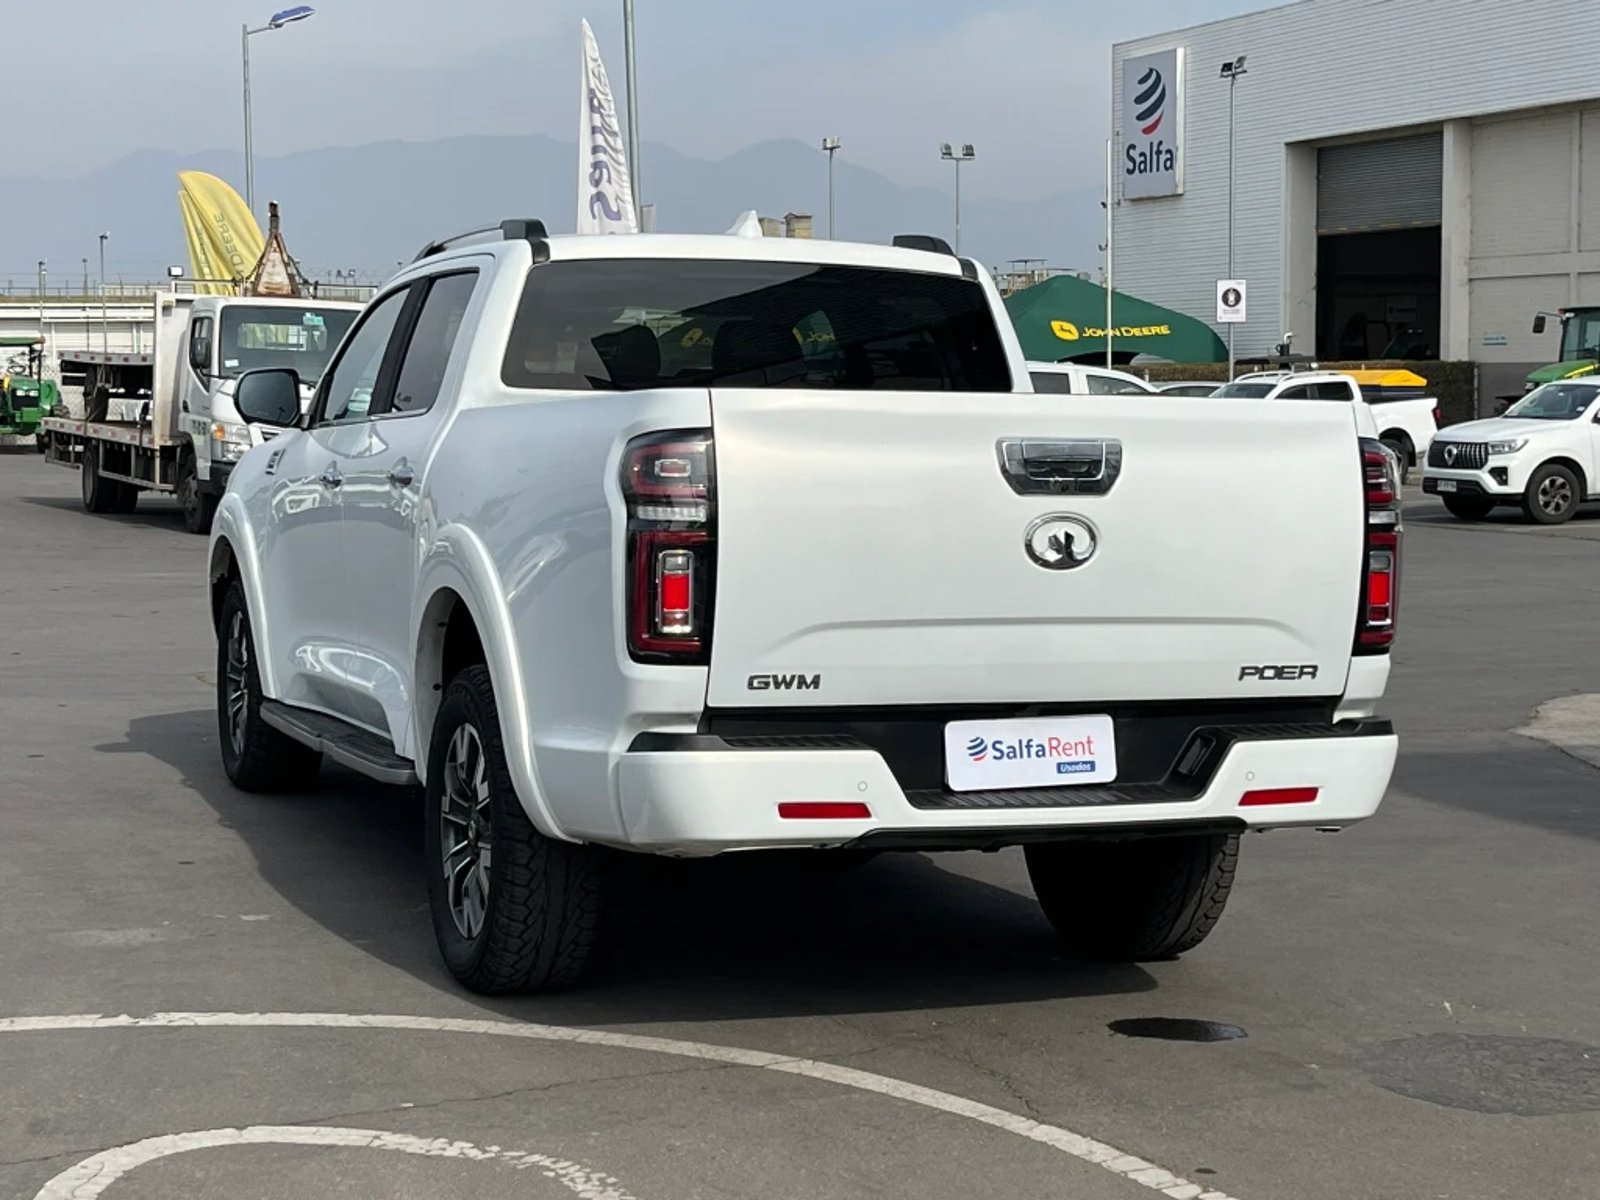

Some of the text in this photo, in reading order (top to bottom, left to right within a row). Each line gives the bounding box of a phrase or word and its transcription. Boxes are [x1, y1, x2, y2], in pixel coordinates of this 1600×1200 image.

[1125, 140, 1174, 175] Salfa
[807, 331, 836, 342] JOH
[1082, 324, 1171, 337] JOHN DEERE
[1238, 664, 1319, 681] POER
[747, 674, 821, 690] GWM
[991, 735, 1095, 761] SalfaRent
[1060, 762, 1092, 772] Usados
